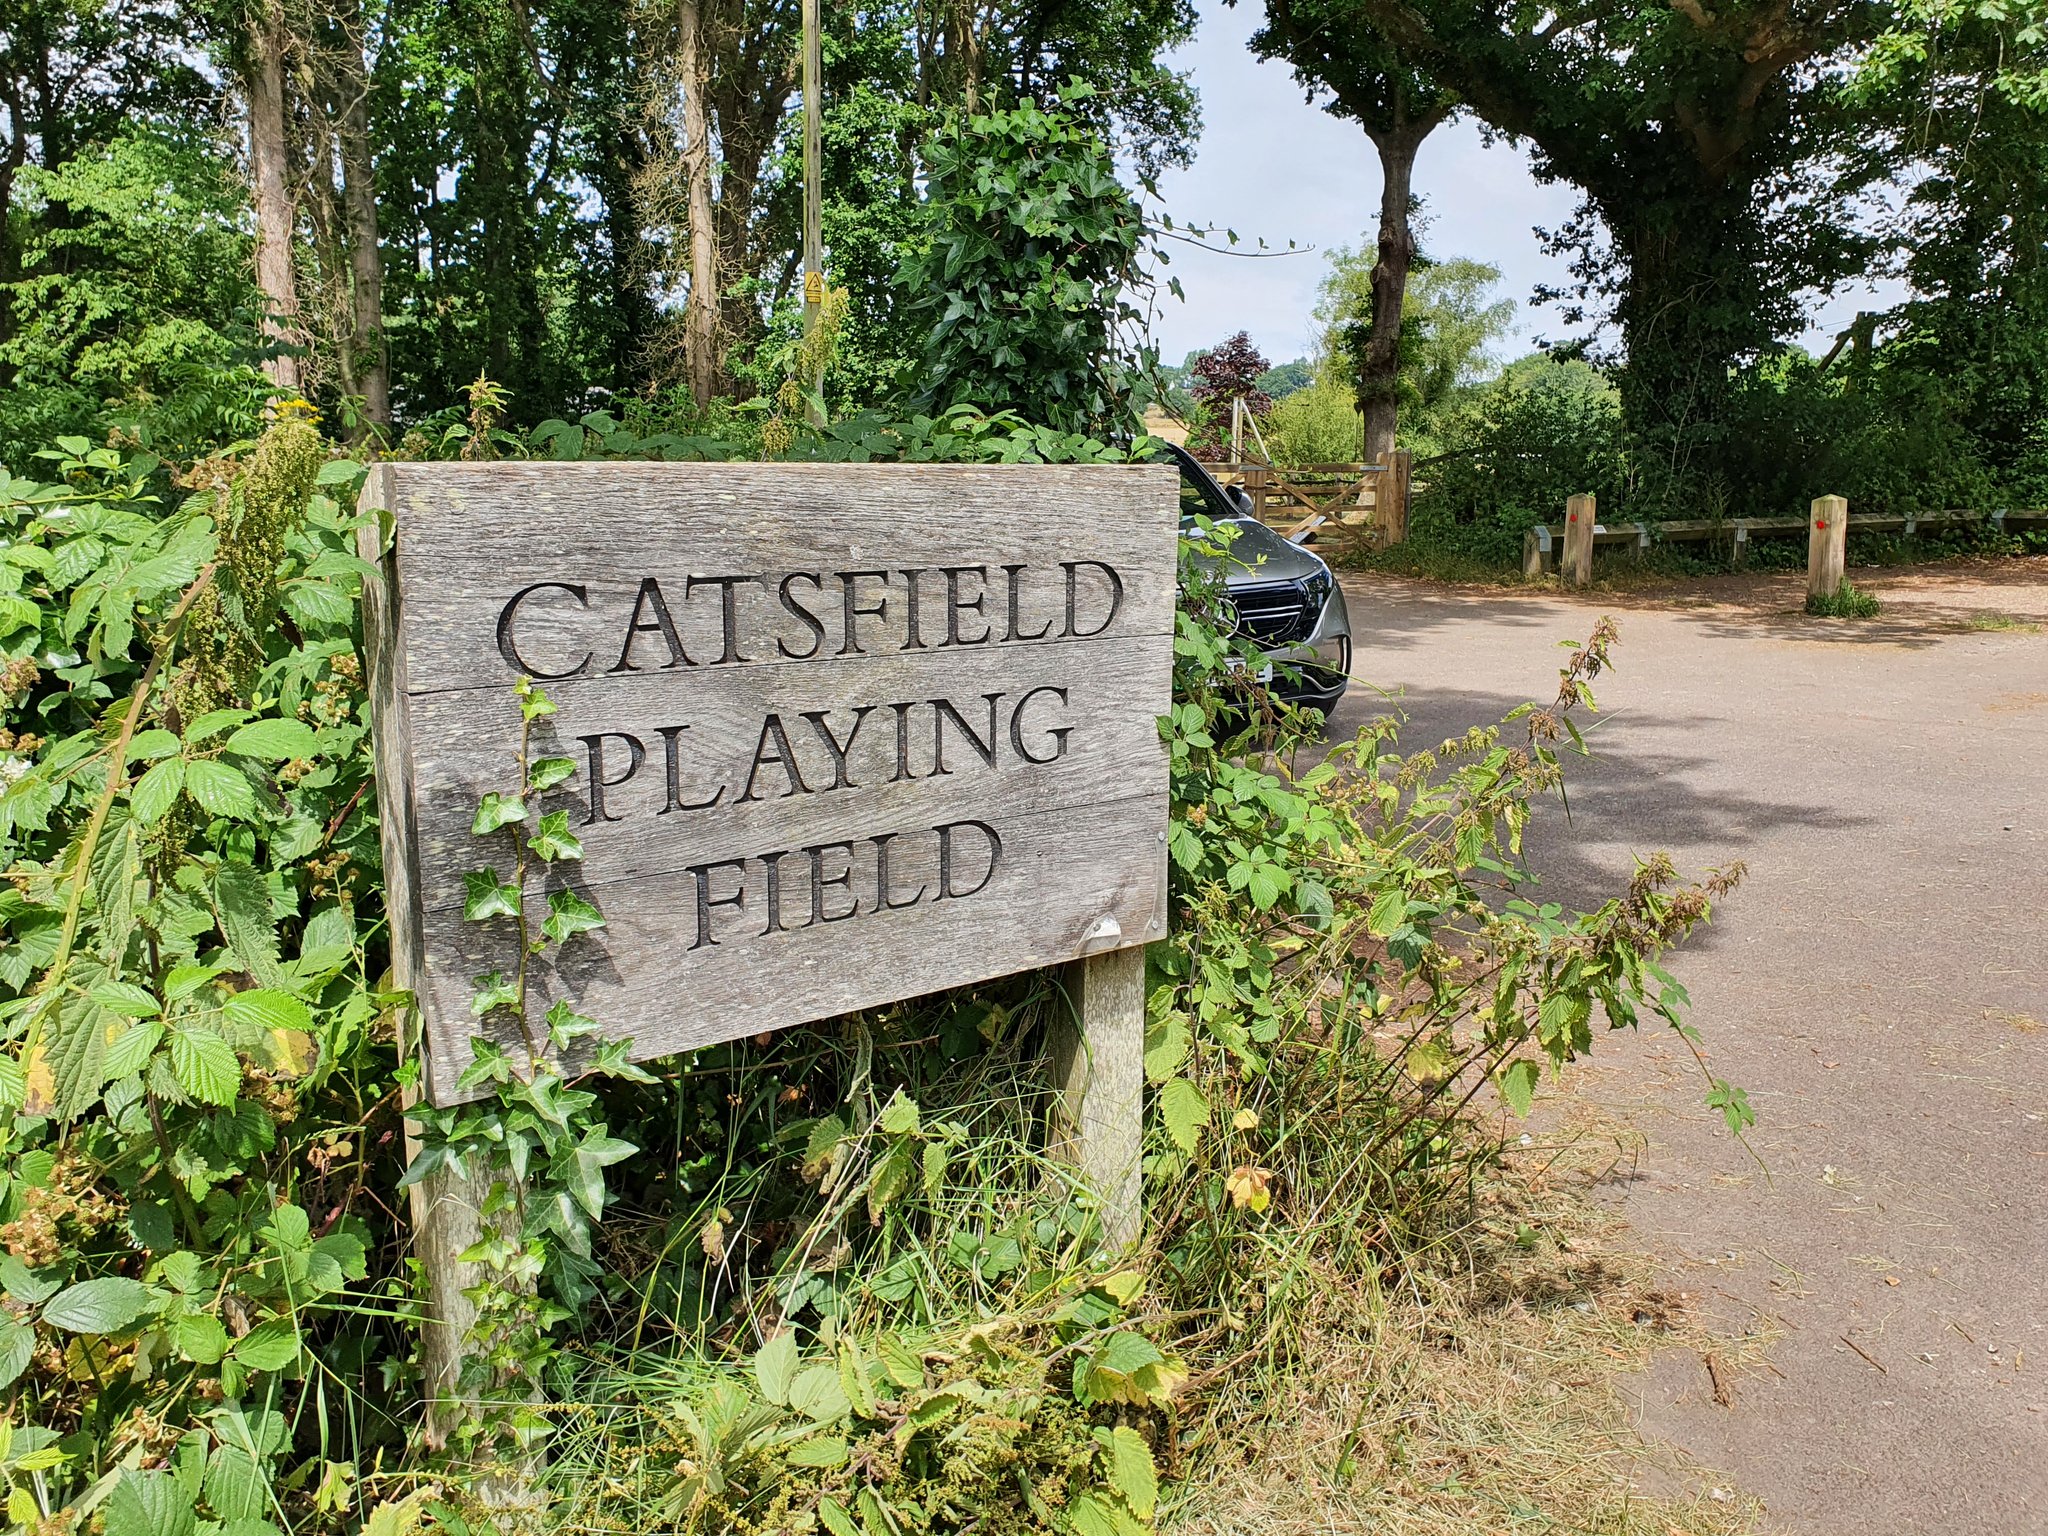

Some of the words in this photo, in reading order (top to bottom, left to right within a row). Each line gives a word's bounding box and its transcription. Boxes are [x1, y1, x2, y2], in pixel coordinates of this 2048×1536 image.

[496, 560, 1125, 681] CATSFIELD
[577, 686, 1075, 826] PLAYING
[685, 819, 1002, 951] FIELD
